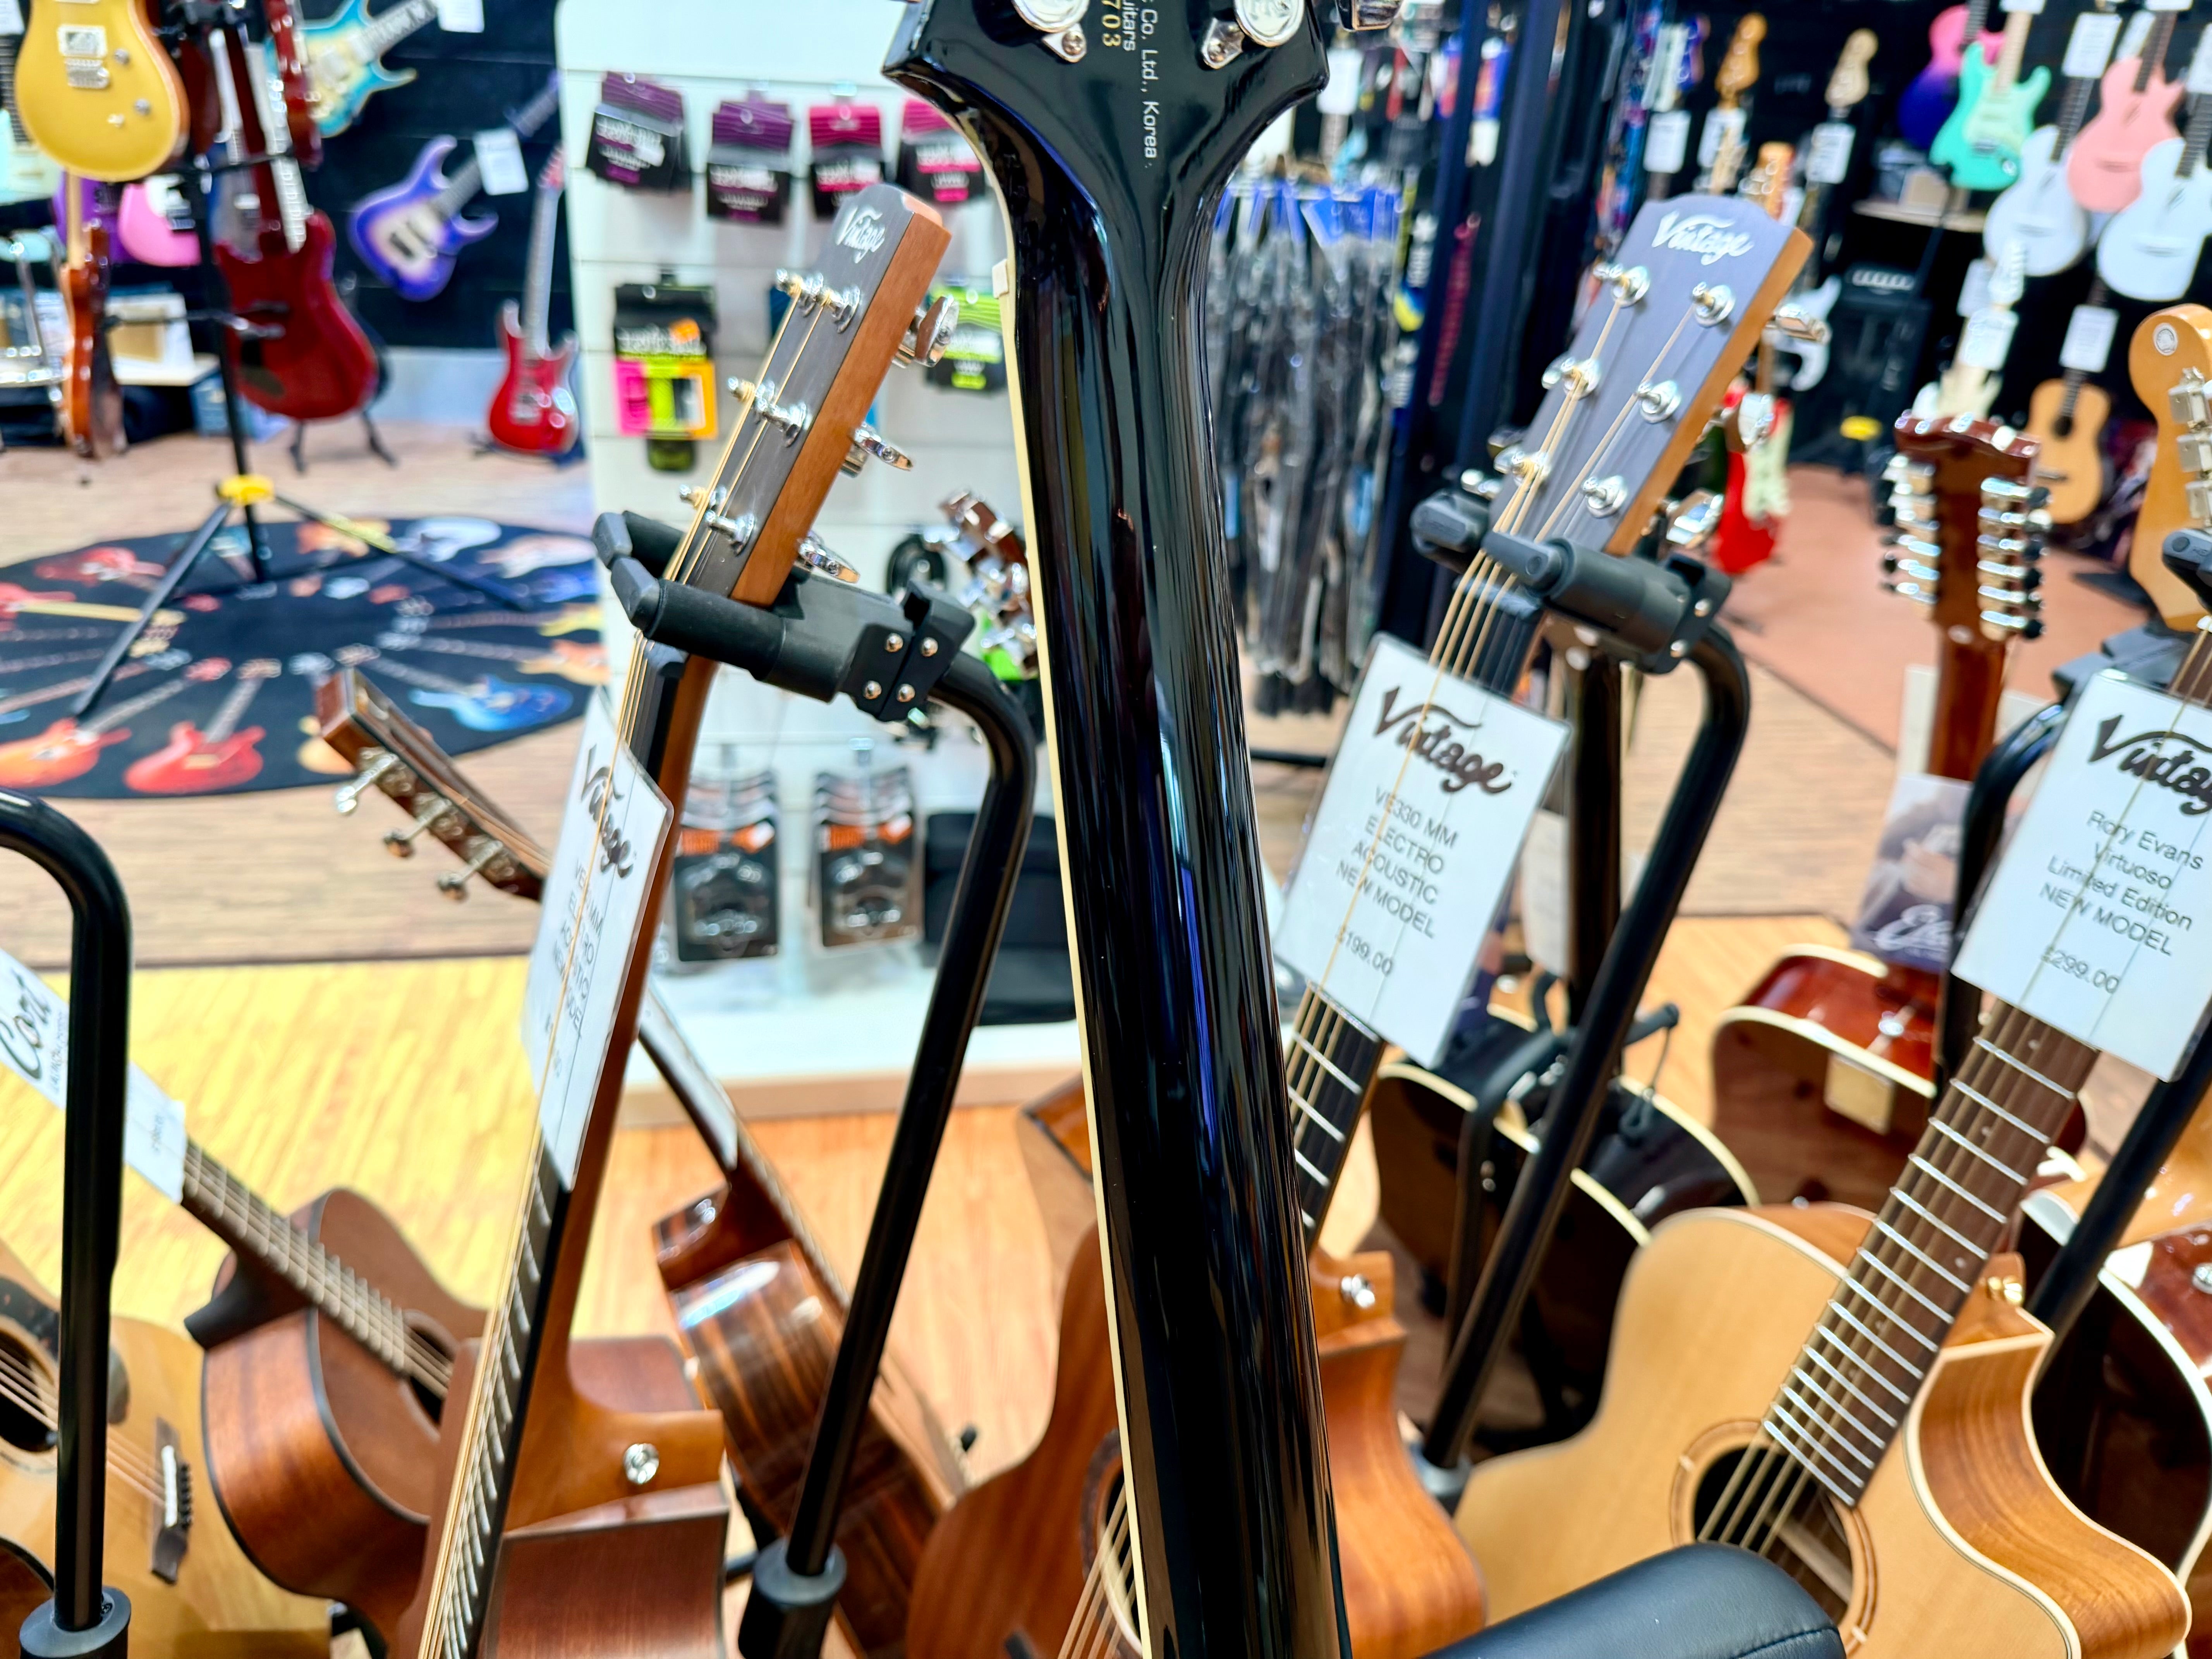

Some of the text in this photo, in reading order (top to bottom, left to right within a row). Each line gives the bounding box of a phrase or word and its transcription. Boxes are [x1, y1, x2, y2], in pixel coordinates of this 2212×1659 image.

[1140, 49, 1159, 93] Ltd.,
[835, 206, 885, 264] Vintage
[1651, 211, 1754, 266] Vintage
[1374, 686, 1512, 793] Vintage
[1365, 815, 1444, 874] EECTRO
[1424, 818, 1458, 848] MM
[2087, 810, 2203, 870] Rory Evans
[1351, 840, 1438, 905] ACOUSTIC
[2095, 842, 2172, 889] Virtuoso
[569, 890, 594, 964] ELTRO
[1336, 860, 1434, 939] NEW MODEL
[2040, 882, 2172, 956] NEW MODEL
[2121, 888, 2192, 931] Edition
[561, 919, 589, 1000] ACSTIC
